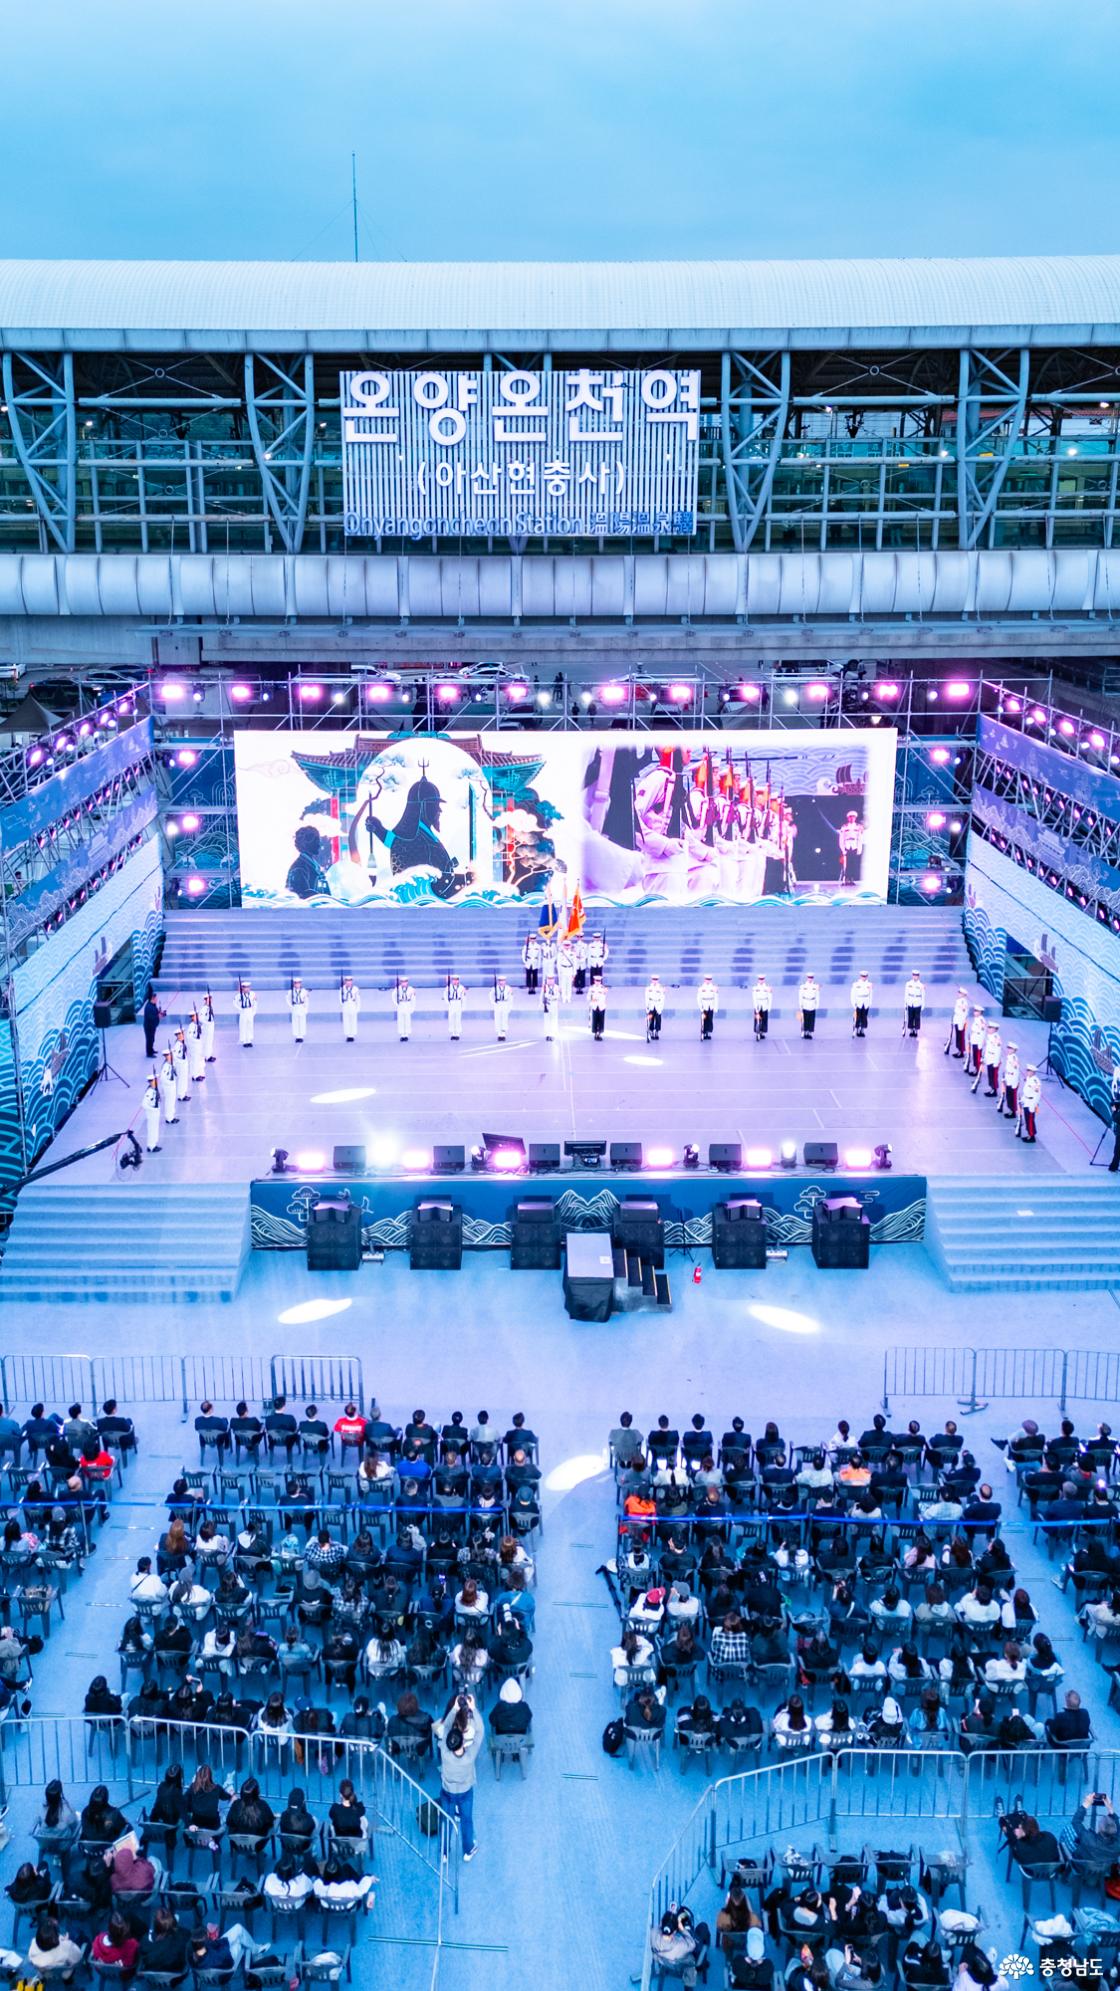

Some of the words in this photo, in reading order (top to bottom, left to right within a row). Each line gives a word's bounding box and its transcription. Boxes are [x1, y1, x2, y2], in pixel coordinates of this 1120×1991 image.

[343, 369, 698, 445] 온양온천역
[417, 460, 625, 496] (아산현충사)
[344, 511, 512, 541] Onyangoncheon
[516, 511, 583, 535] Station
